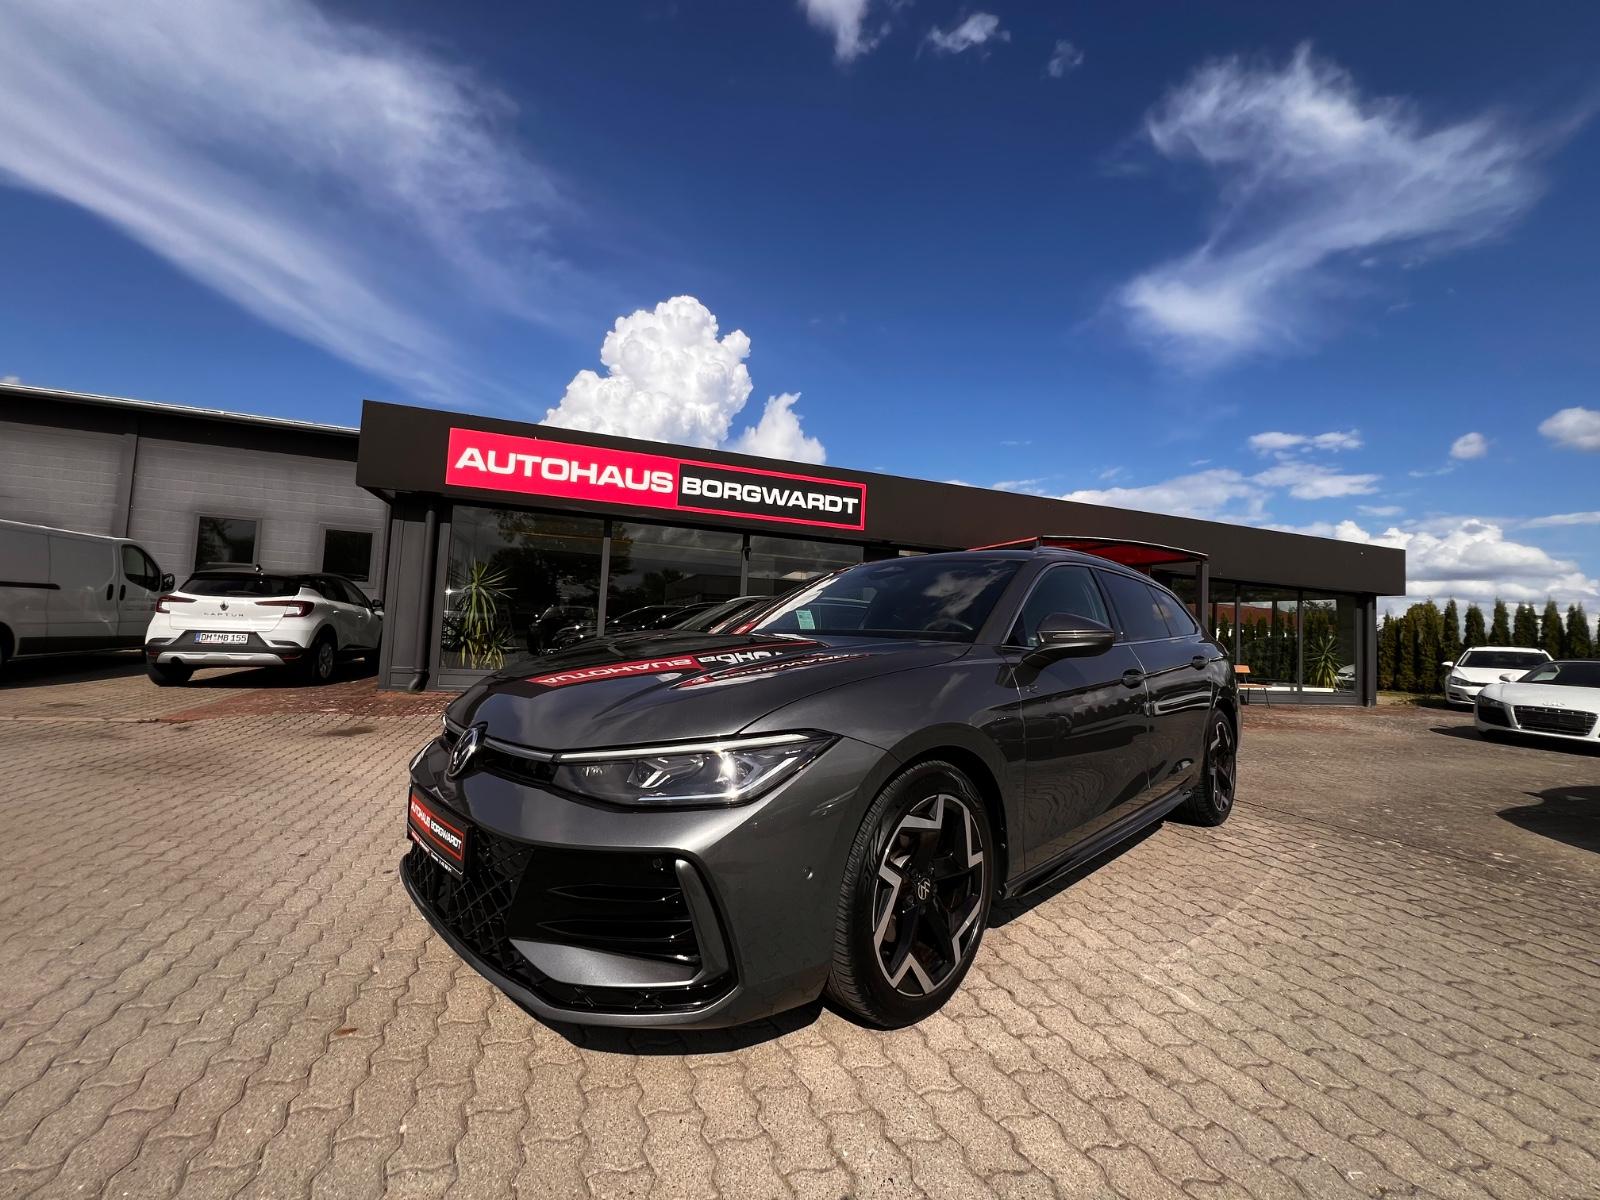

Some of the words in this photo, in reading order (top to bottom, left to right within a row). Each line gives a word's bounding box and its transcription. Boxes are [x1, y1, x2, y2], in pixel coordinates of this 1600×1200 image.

[454, 447, 674, 494] AUTOHAUS
[681, 476, 859, 515] BORGWARDT
[217, 634, 229, 642] MB
[230, 634, 247, 642] 155
[430, 820, 462, 850] BORGWARDT
